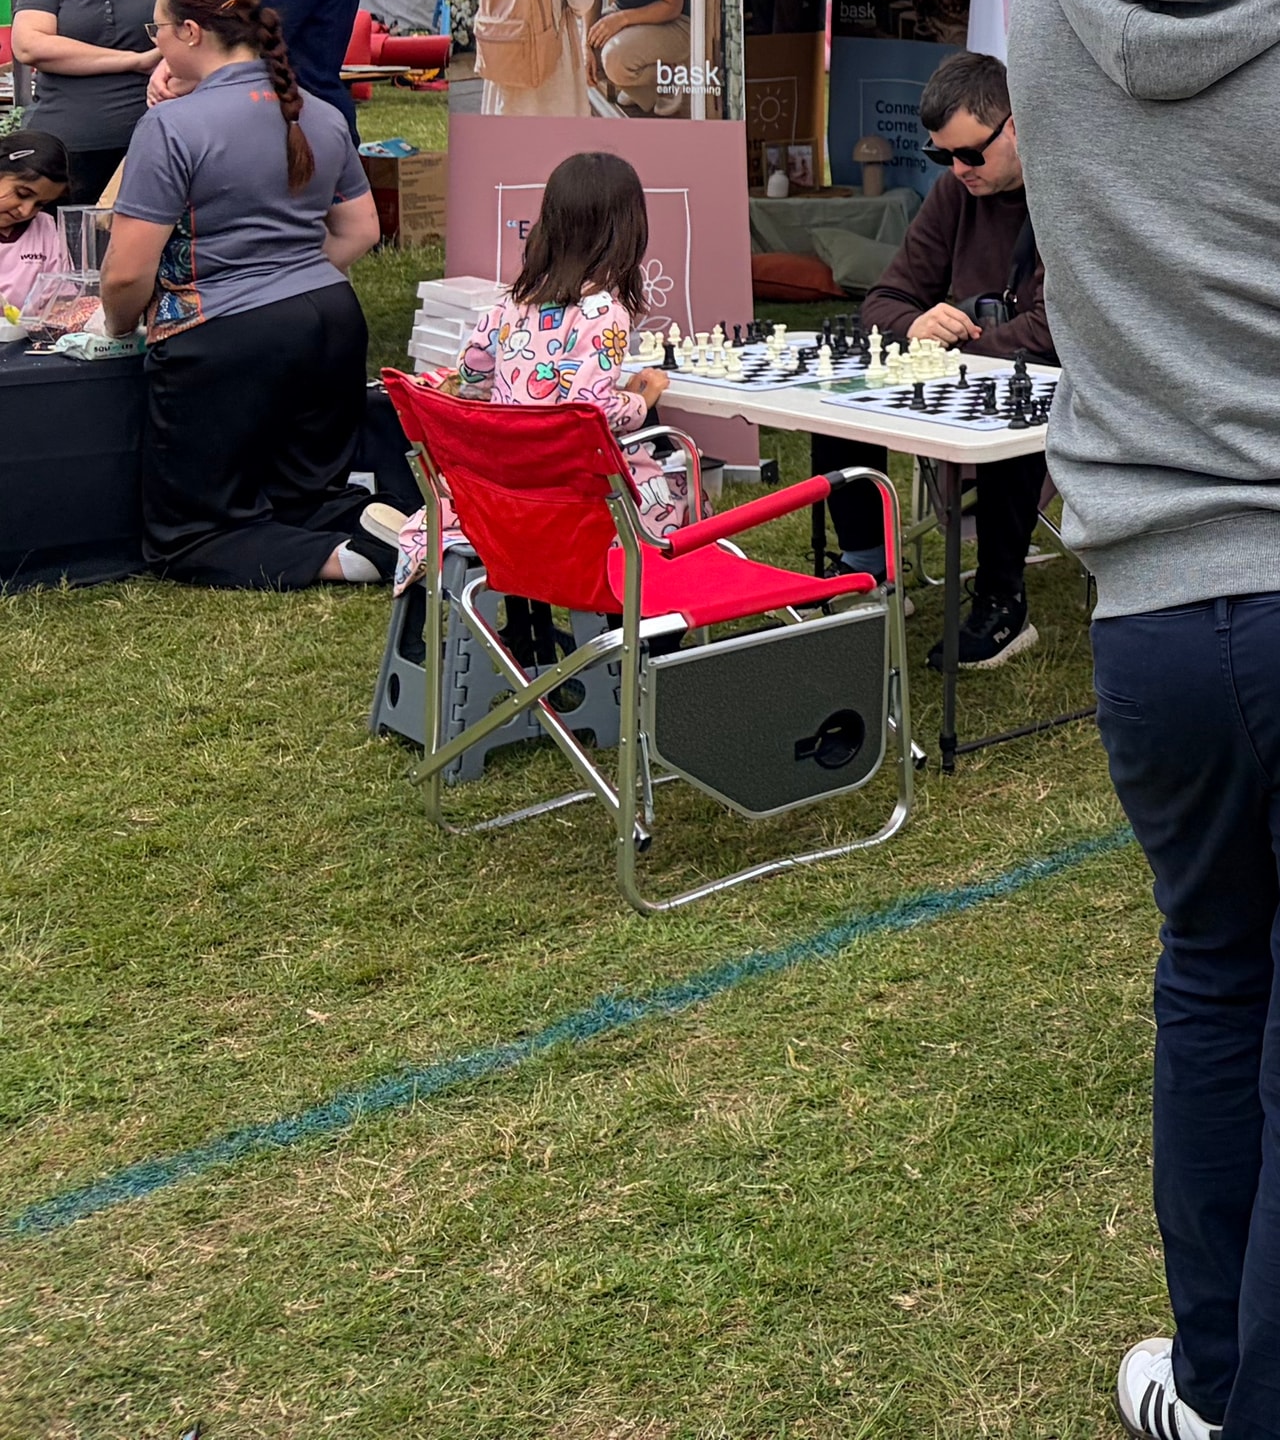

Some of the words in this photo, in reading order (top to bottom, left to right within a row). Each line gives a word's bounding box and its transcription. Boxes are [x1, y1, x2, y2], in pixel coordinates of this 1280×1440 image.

[840, 1, 877, 19] bask
[656, 58, 721, 86] bask
[656, 85, 680, 96] early
[682, 85, 722, 96] learning
[877, 121, 918, 133] comes
